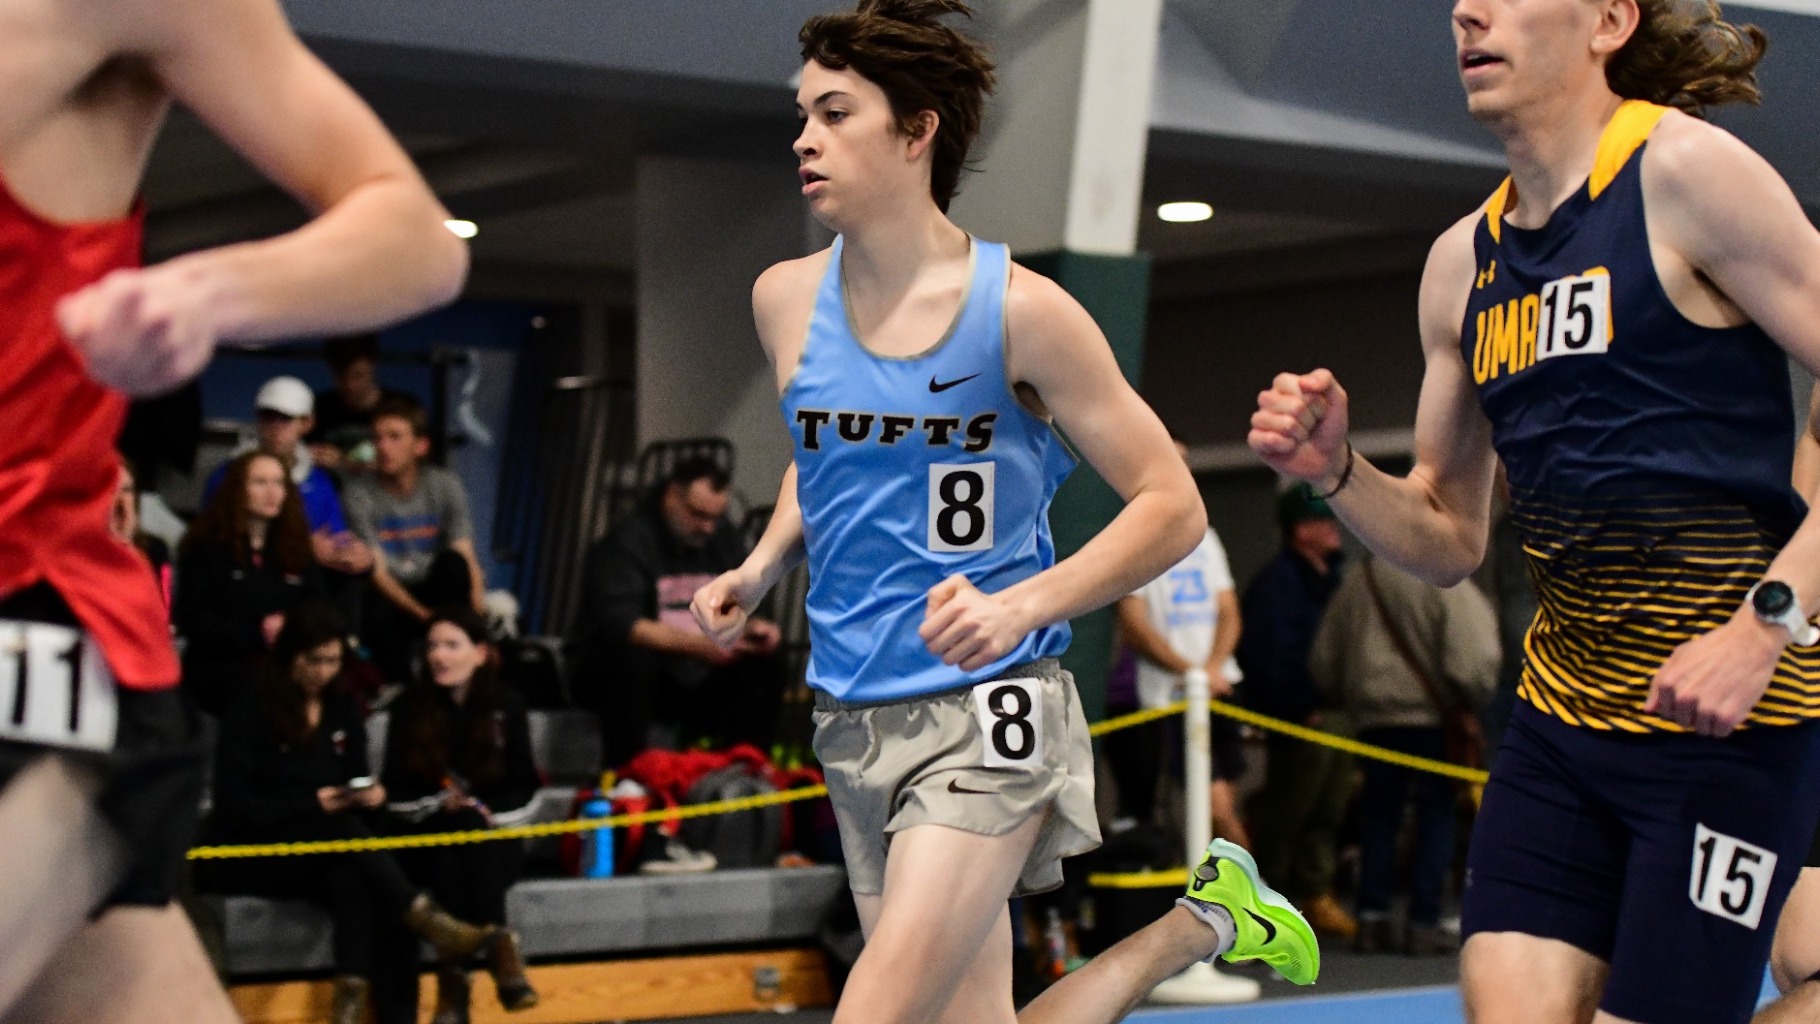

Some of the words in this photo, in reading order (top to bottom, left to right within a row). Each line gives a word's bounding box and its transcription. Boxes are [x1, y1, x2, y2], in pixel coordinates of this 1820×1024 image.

[1545, 281, 1593, 352] 15
[797, 410, 997, 452] TUFTS
[936, 470, 986, 546] 8
[8, 637, 84, 734] 11
[988, 684, 1036, 760] 8
[1696, 836, 1762, 915] 15
